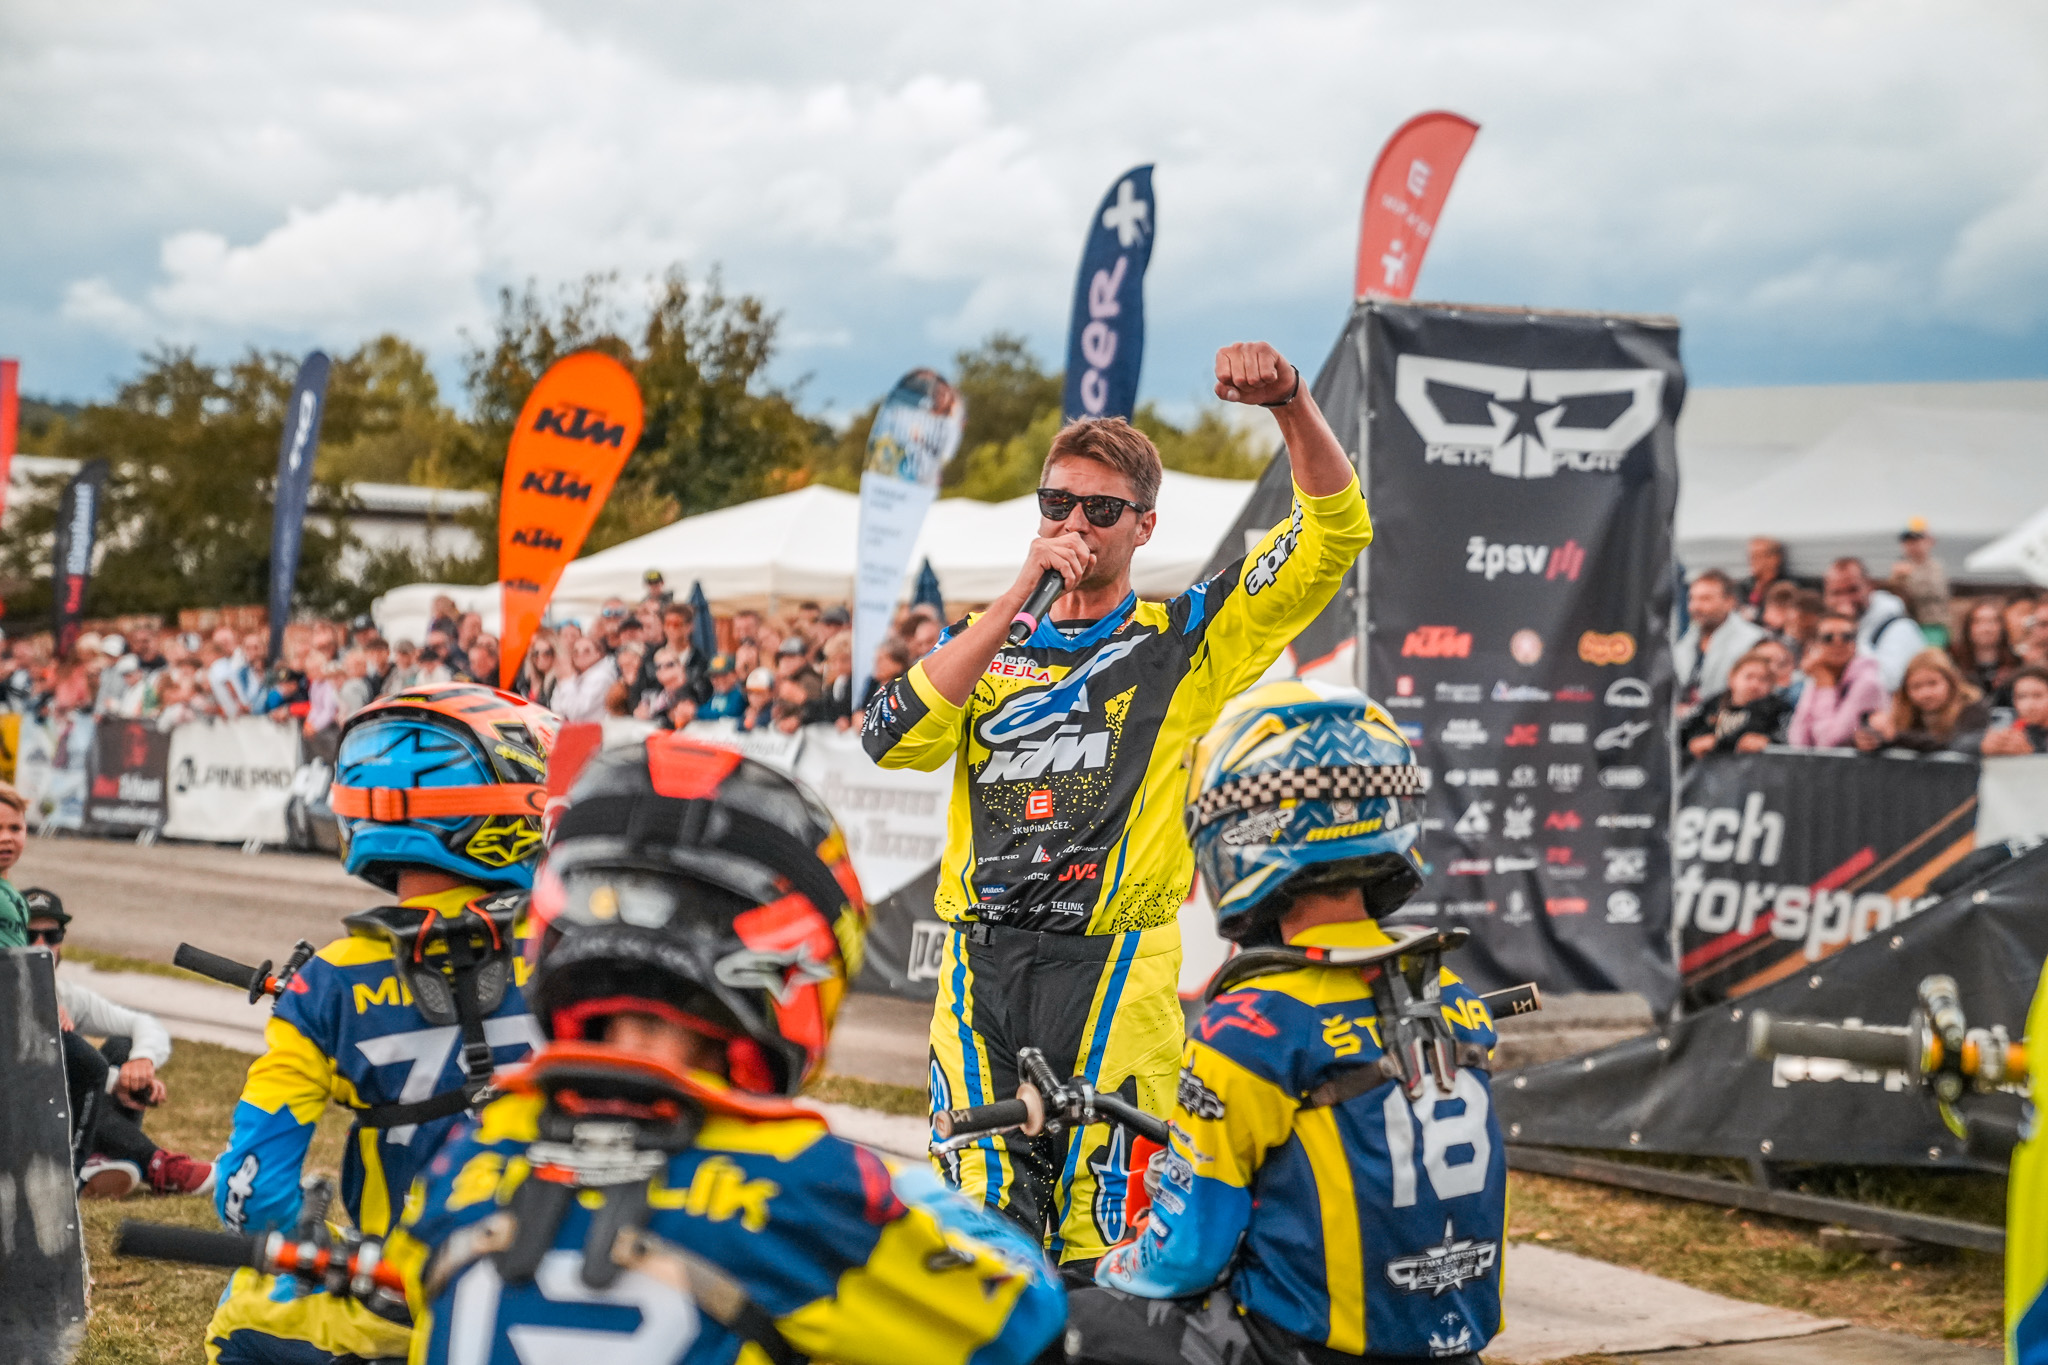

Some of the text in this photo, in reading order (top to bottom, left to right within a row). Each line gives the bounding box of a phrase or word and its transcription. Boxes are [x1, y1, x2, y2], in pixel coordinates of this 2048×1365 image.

[533, 403, 625, 448] KTM
[520, 467, 592, 503] KTM
[511, 527, 563, 552] KTM
[1466, 536, 1549, 580] žpsv
[1401, 626, 1473, 658] KTM
[989, 661, 1050, 683] REJLA
[995, 653, 1037, 667] AUTO
[976, 724, 1110, 784] KTM
[1012, 820, 1070, 835] SKUPINA ČEZ
[1001, 853, 1020, 861] PRO
[1051, 900, 1085, 912] TELINK
[1383, 1067, 1491, 1209] 18
